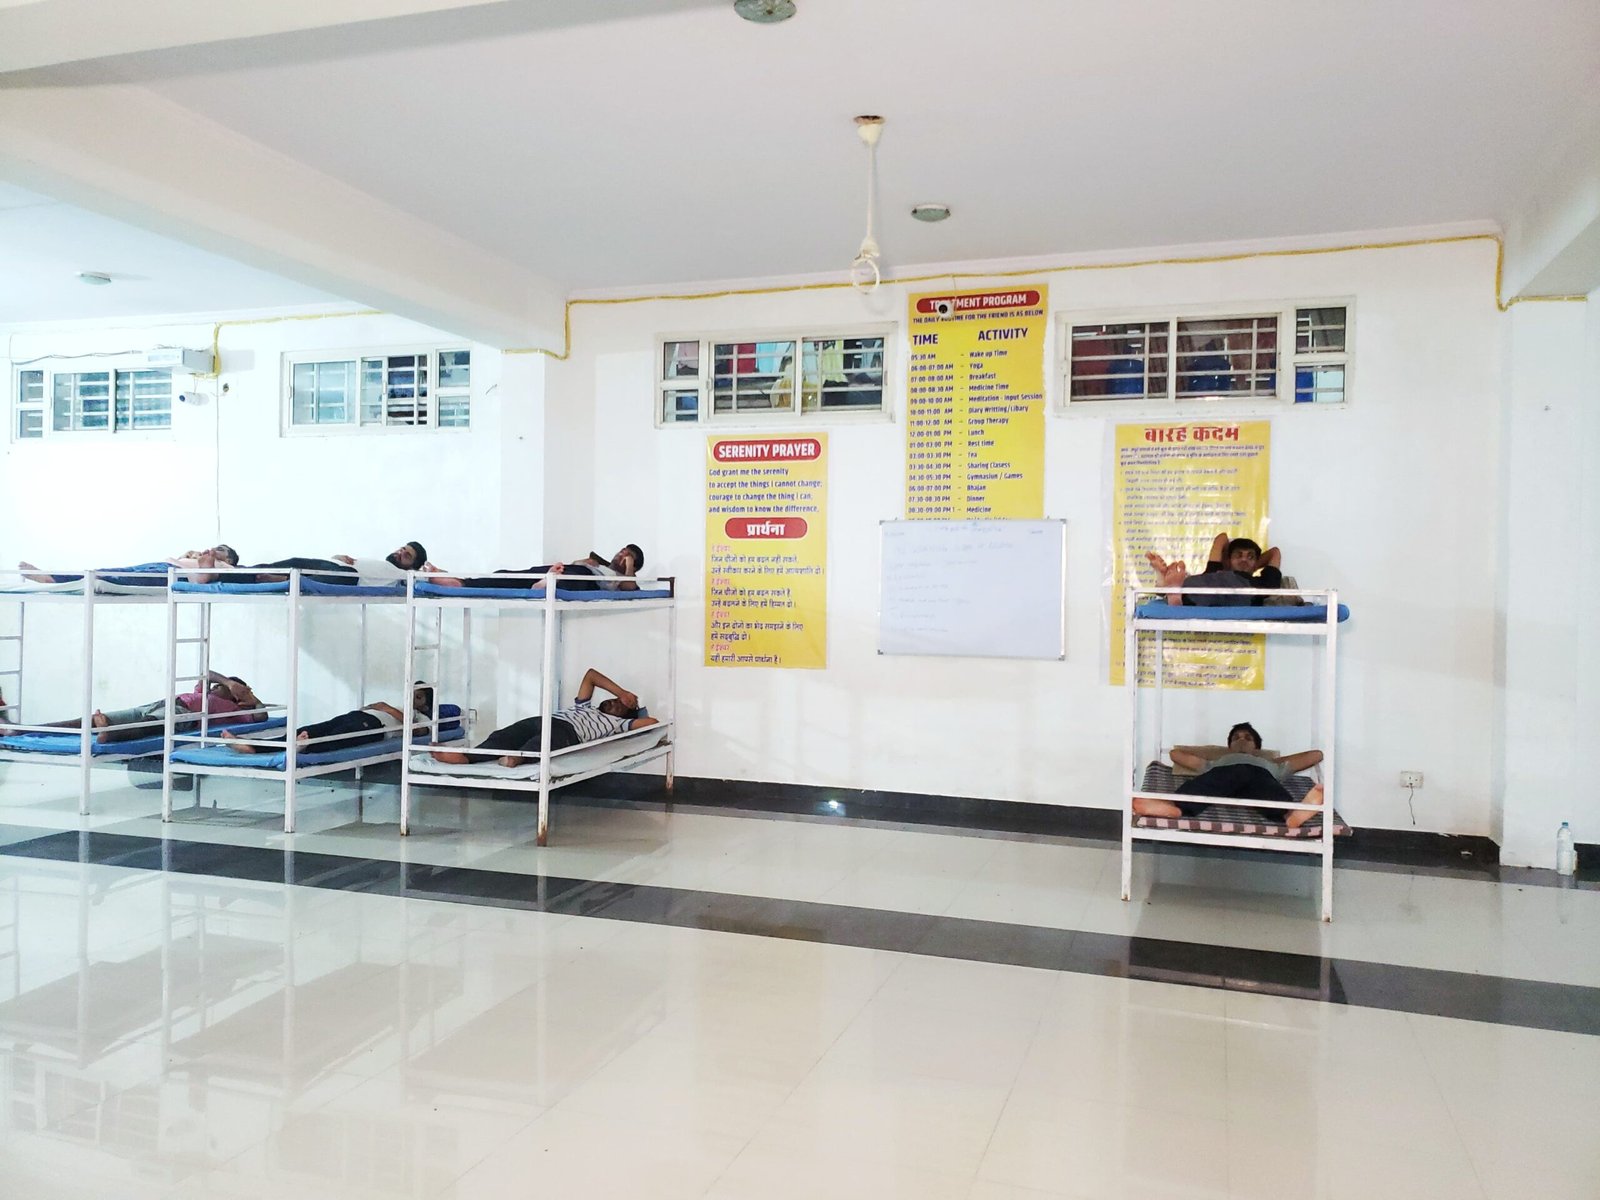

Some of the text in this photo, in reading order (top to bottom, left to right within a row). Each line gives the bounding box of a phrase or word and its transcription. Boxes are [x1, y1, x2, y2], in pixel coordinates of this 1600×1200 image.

[930, 294, 1027, 310] TMENT PROGRAM
[913, 328, 1028, 345] TIME ACTIVITY
[985, 351, 993, 359] up
[969, 373, 996, 381] Breakfast
[1020, 393, 1043, 401] Session
[968, 407, 983, 415] Diary
[968, 418, 985, 426] Group
[986, 417, 1009, 425] Therapy
[1144, 426, 1240, 443] बारह कदम
[718, 443, 815, 458] SERENITY PRAYER
[942, 451, 952, 459] PM
[967, 462, 989, 470] Sharing
[709, 468, 720, 476] God
[722, 469, 738, 477] grant
[762, 467, 789, 476] serenity
[750, 480, 770, 489] things
[742, 493, 765, 501] change
[778, 492, 795, 501] thing
[721, 505, 745, 513] wisdom
[746, 520, 786, 536] प्रार्थना
